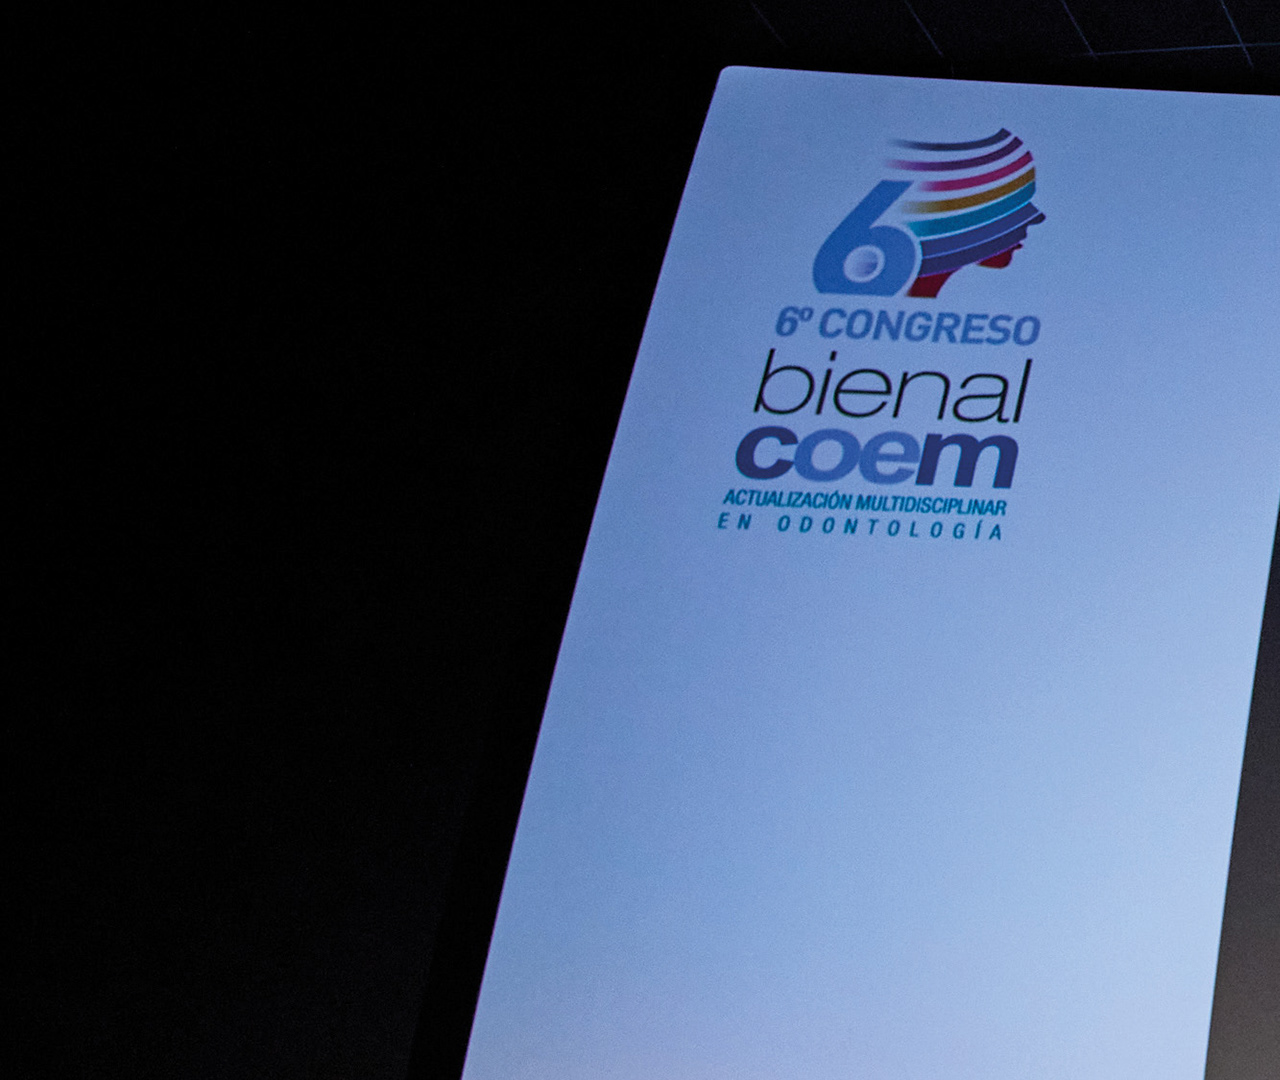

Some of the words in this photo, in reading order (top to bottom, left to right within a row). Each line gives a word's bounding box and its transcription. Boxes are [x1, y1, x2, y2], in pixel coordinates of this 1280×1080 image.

[812, 180, 914, 297] 6
[819, 307, 1041, 346] CONGRESO
[753, 348, 1033, 423] bienal
[736, 425, 1019, 489] coem
[717, 512, 752, 530] EN
[777, 515, 1001, 540] ODONTOLOGÍA
[723, 488, 850, 510] ACTUALIZACIÓN
[855, 495, 1007, 516] MULTIDISCIPLINAR
